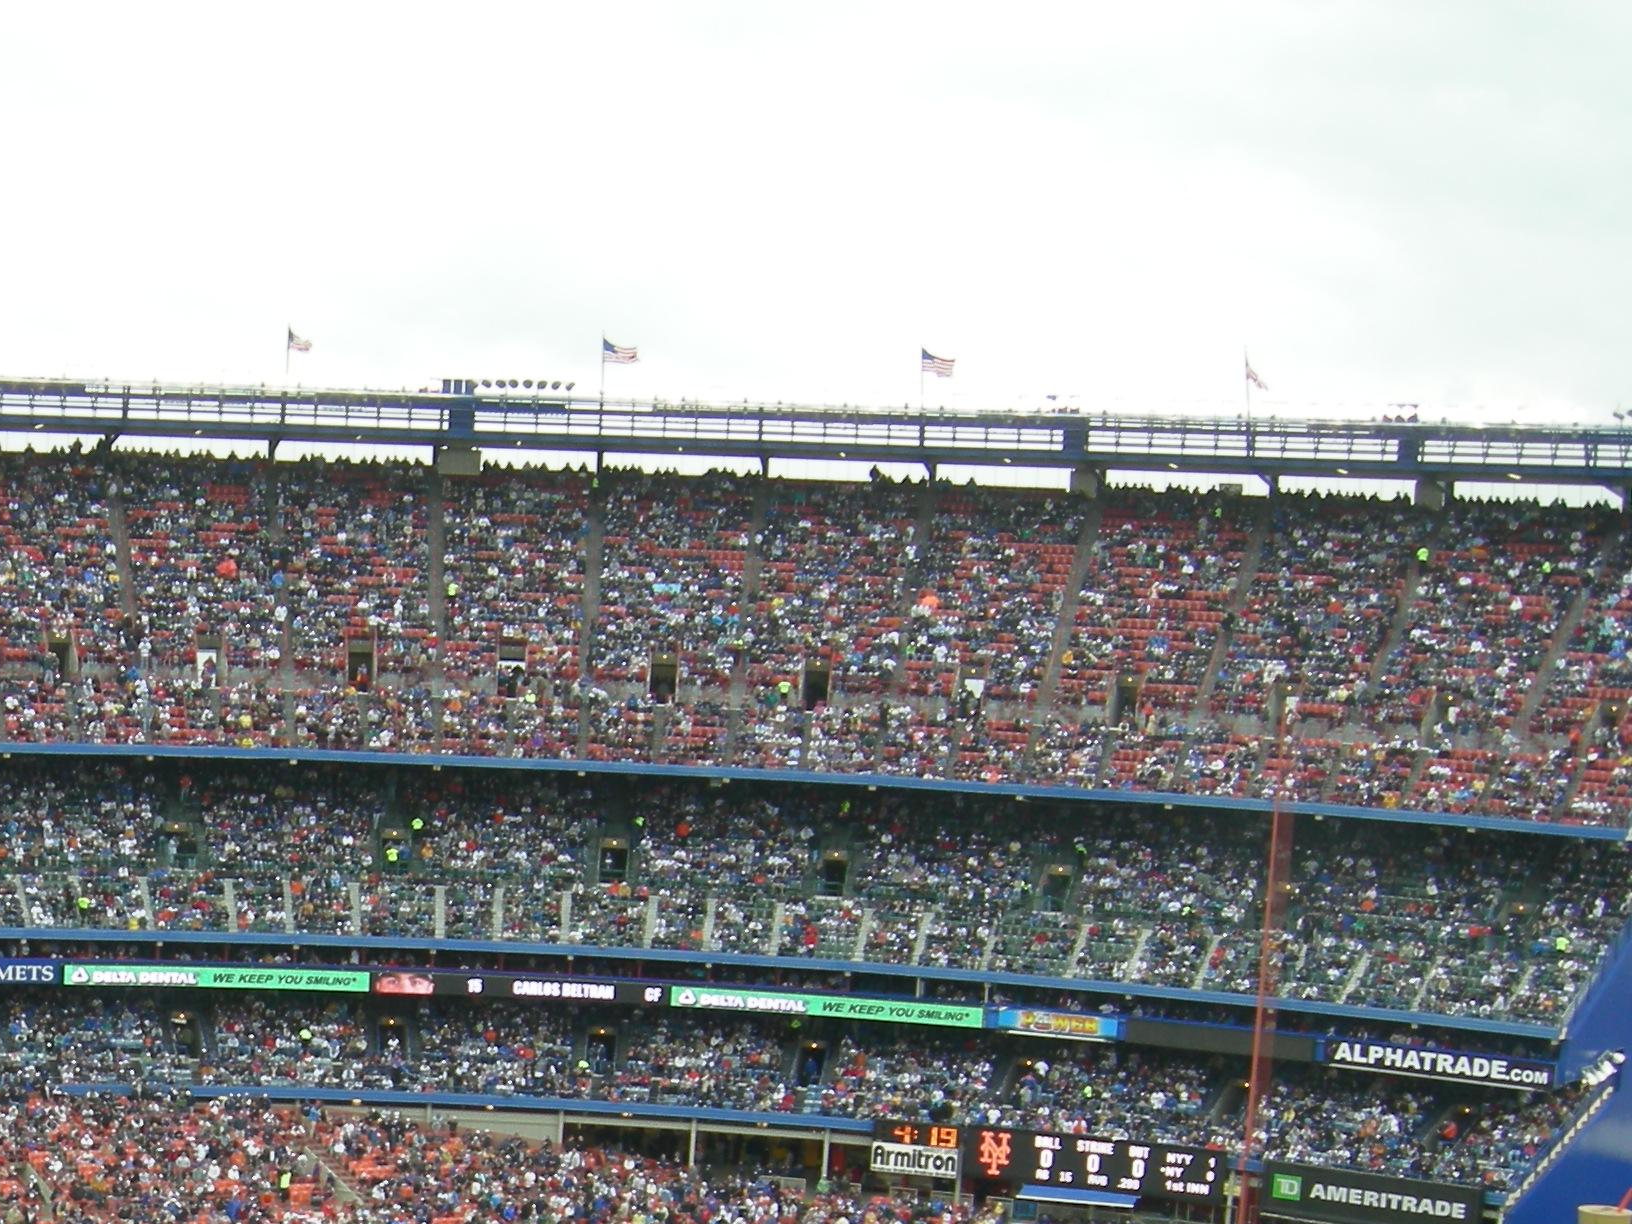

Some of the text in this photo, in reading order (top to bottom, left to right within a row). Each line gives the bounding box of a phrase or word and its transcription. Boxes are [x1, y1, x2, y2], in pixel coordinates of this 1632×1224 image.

[92, 970, 198, 985] DELTA DENTAL
[213, 972, 234, 983] WE
[239, 973, 273, 984] KEEP
[277, 975, 303, 985] YOU
[467, 979, 483, 993] 15
[513, 981, 614, 1000] CARLOS BELTRAN
[645, 987, 662, 1002] CF
[700, 992, 806, 1013] DELTA DENTAL
[822, 1001, 845, 1013] WE
[848, 1003, 885, 1015] KEEP
[889, 1006, 915, 1018] YOU
[1333, 1042, 1548, 1085] ALPHATRADE.COM
[1035, 1135, 1150, 1159] BALL STRIKE OUT
[873, 1144, 956, 1172] Armitron
[1040, 1149, 1145, 1178] 0 0 0
[1166, 1152, 1193, 1165] NYY
[1186, 1182, 1210, 1195] INN
[1277, 1177, 1466, 1220] TD AMERITRADE
